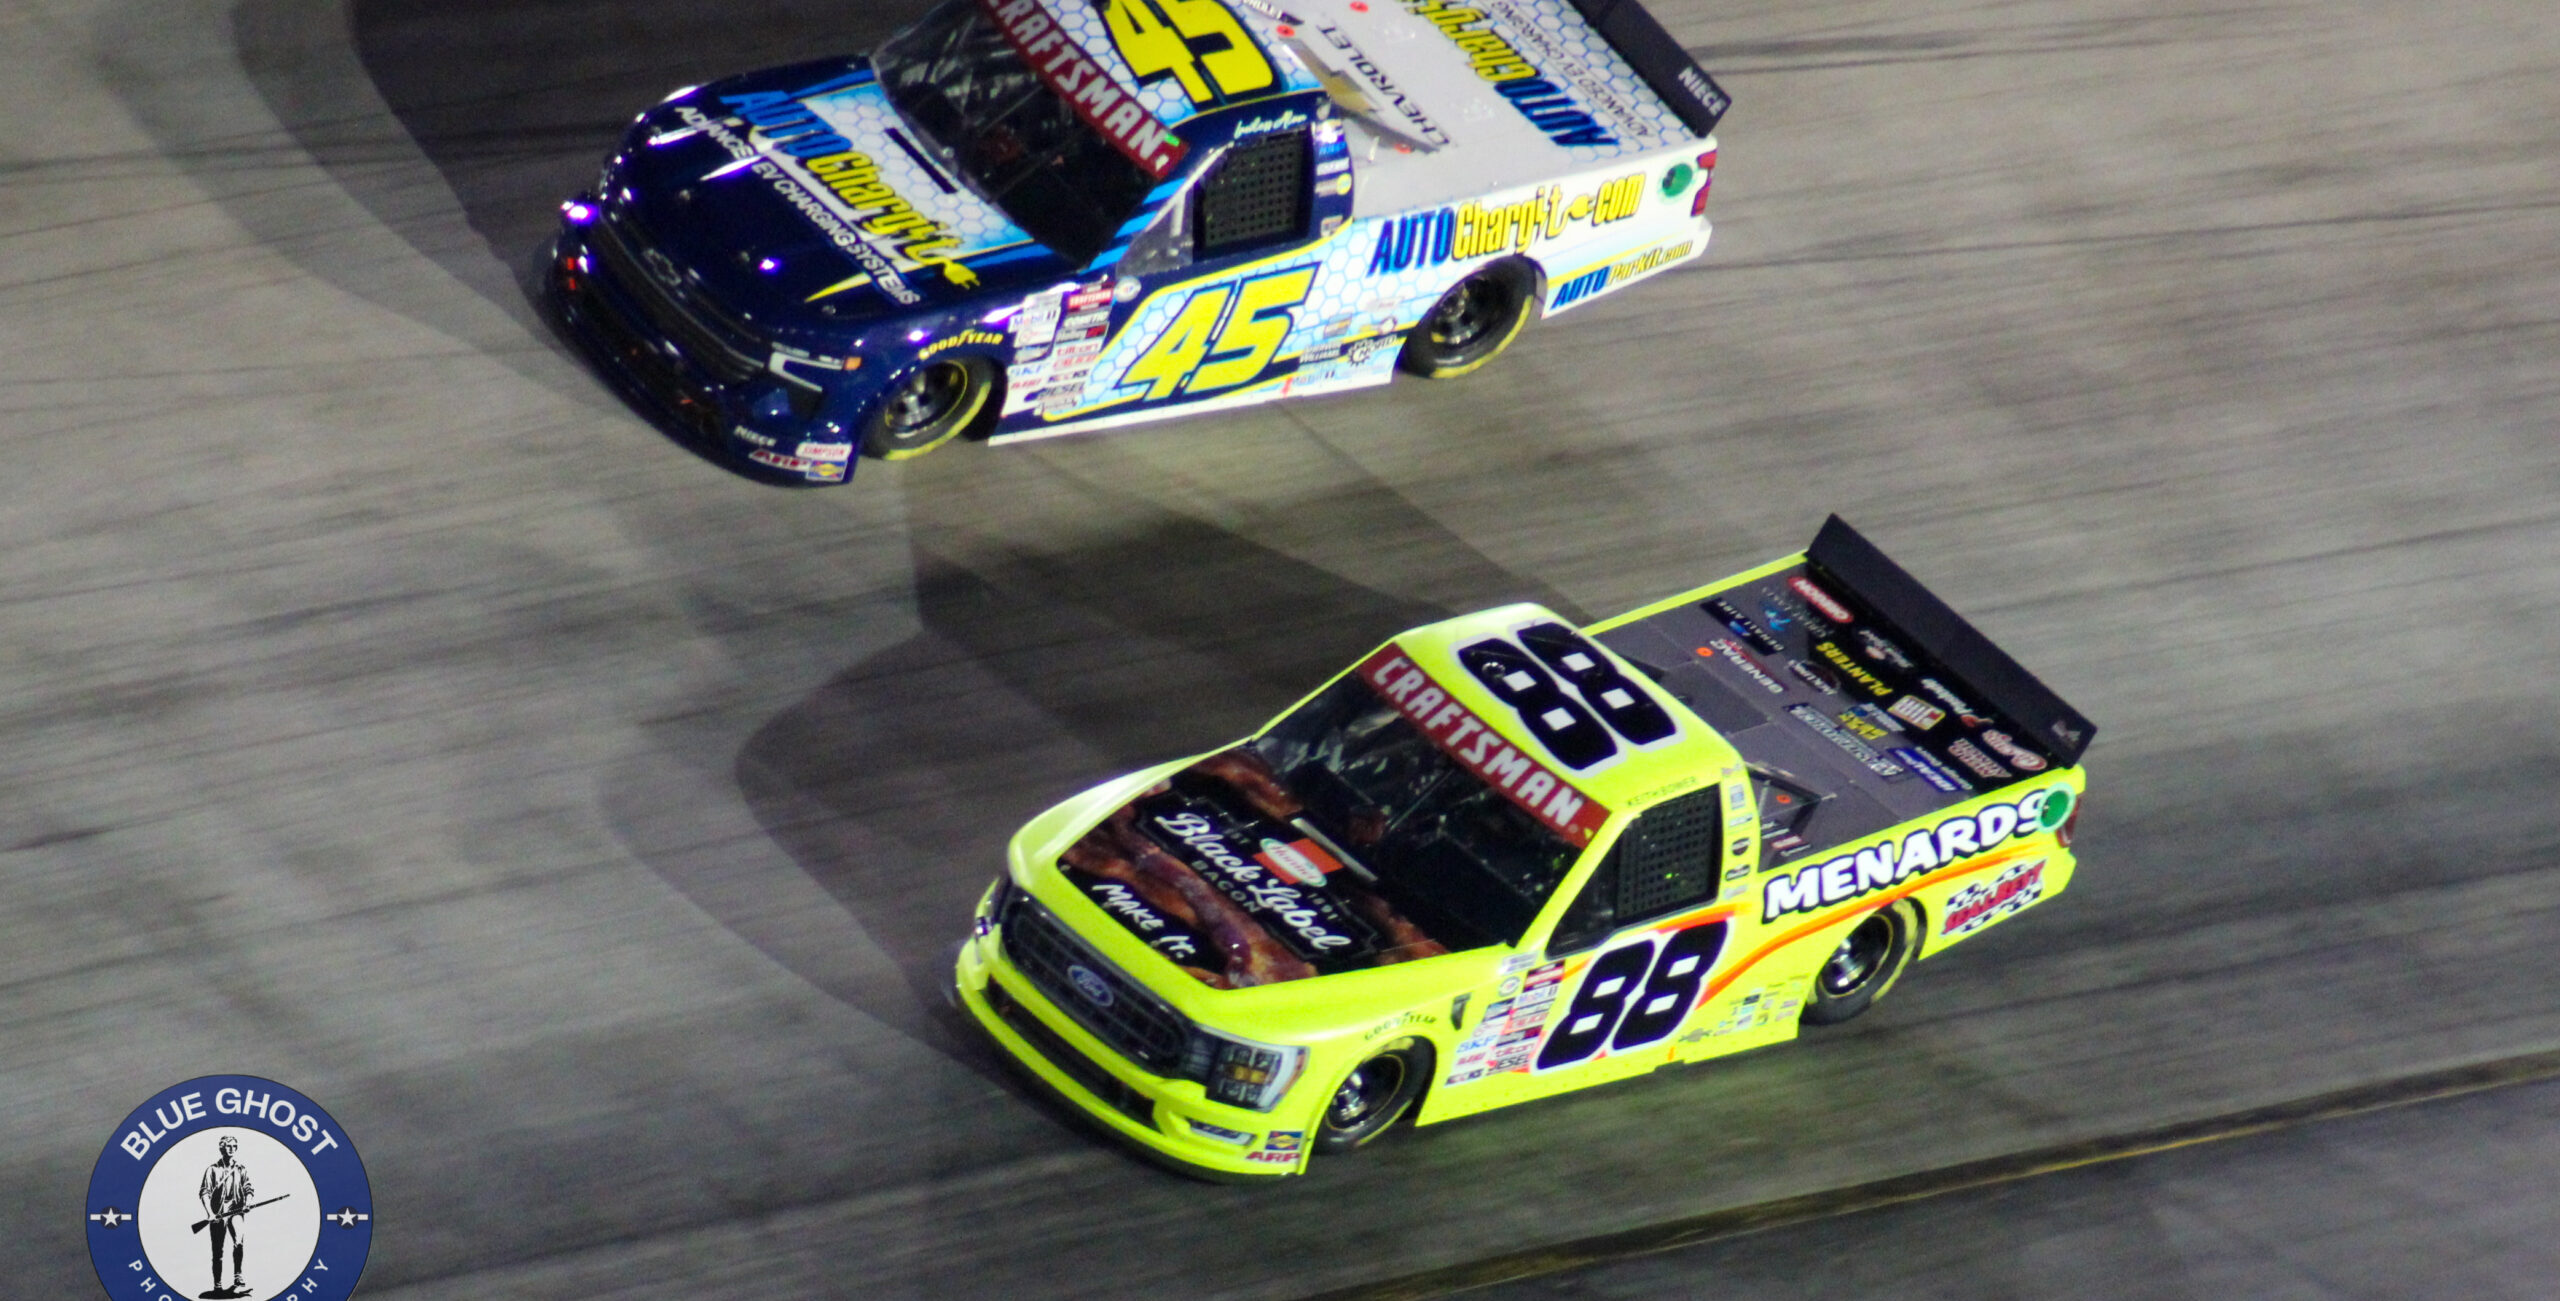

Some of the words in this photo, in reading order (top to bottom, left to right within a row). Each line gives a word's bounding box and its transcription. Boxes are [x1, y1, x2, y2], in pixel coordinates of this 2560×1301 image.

[1316, 22, 1450, 146] CHEVROLET
[773, 179, 856, 247] CHARGING
[851, 243, 921, 304] SYSTEMS
[918, 330, 1004, 360] GOODYEAR
[1117, 264, 1320, 401] 45
[1457, 617, 1677, 771] 88
[1709, 638, 1785, 694] GENERAC
[1816, 642, 1894, 697] PLANTERS
[1372, 655, 1584, 827] CRAFTSMAN
[1154, 812, 1263, 883] Black
[1246, 877, 1351, 950] Label
[1191, 859, 1263, 914] BACON
[1762, 787, 2050, 924] MENARDS
[1536, 921, 1726, 1072] 88
[1245, 1150, 1300, 1163] ARP
